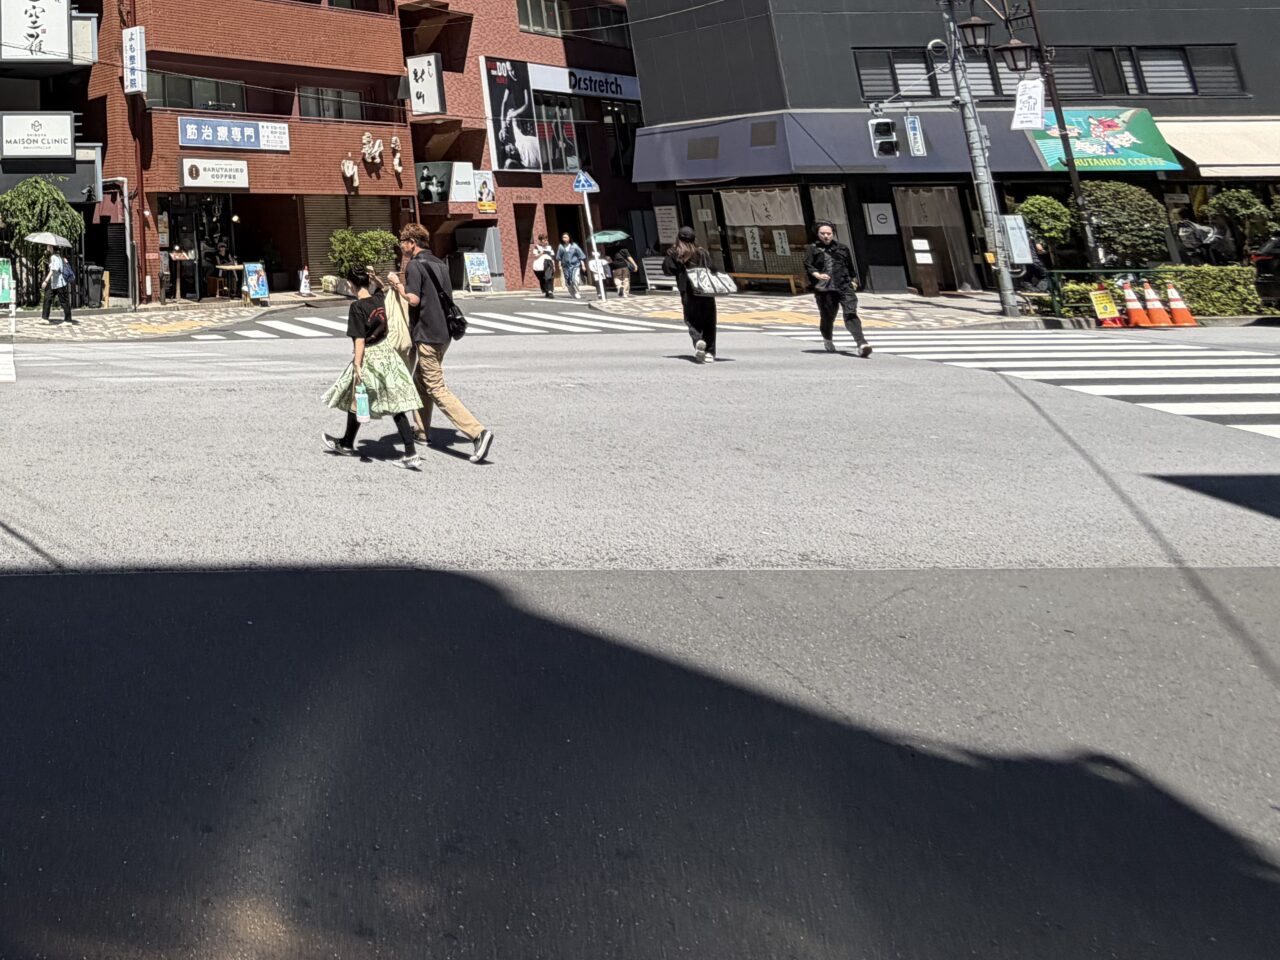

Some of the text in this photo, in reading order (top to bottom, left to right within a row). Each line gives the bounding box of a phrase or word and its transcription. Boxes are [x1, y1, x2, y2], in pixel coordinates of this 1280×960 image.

[186, 124, 255, 142] 筋治療専門
[1073, 157, 1167, 167] RUTAHIKO COFFEE
